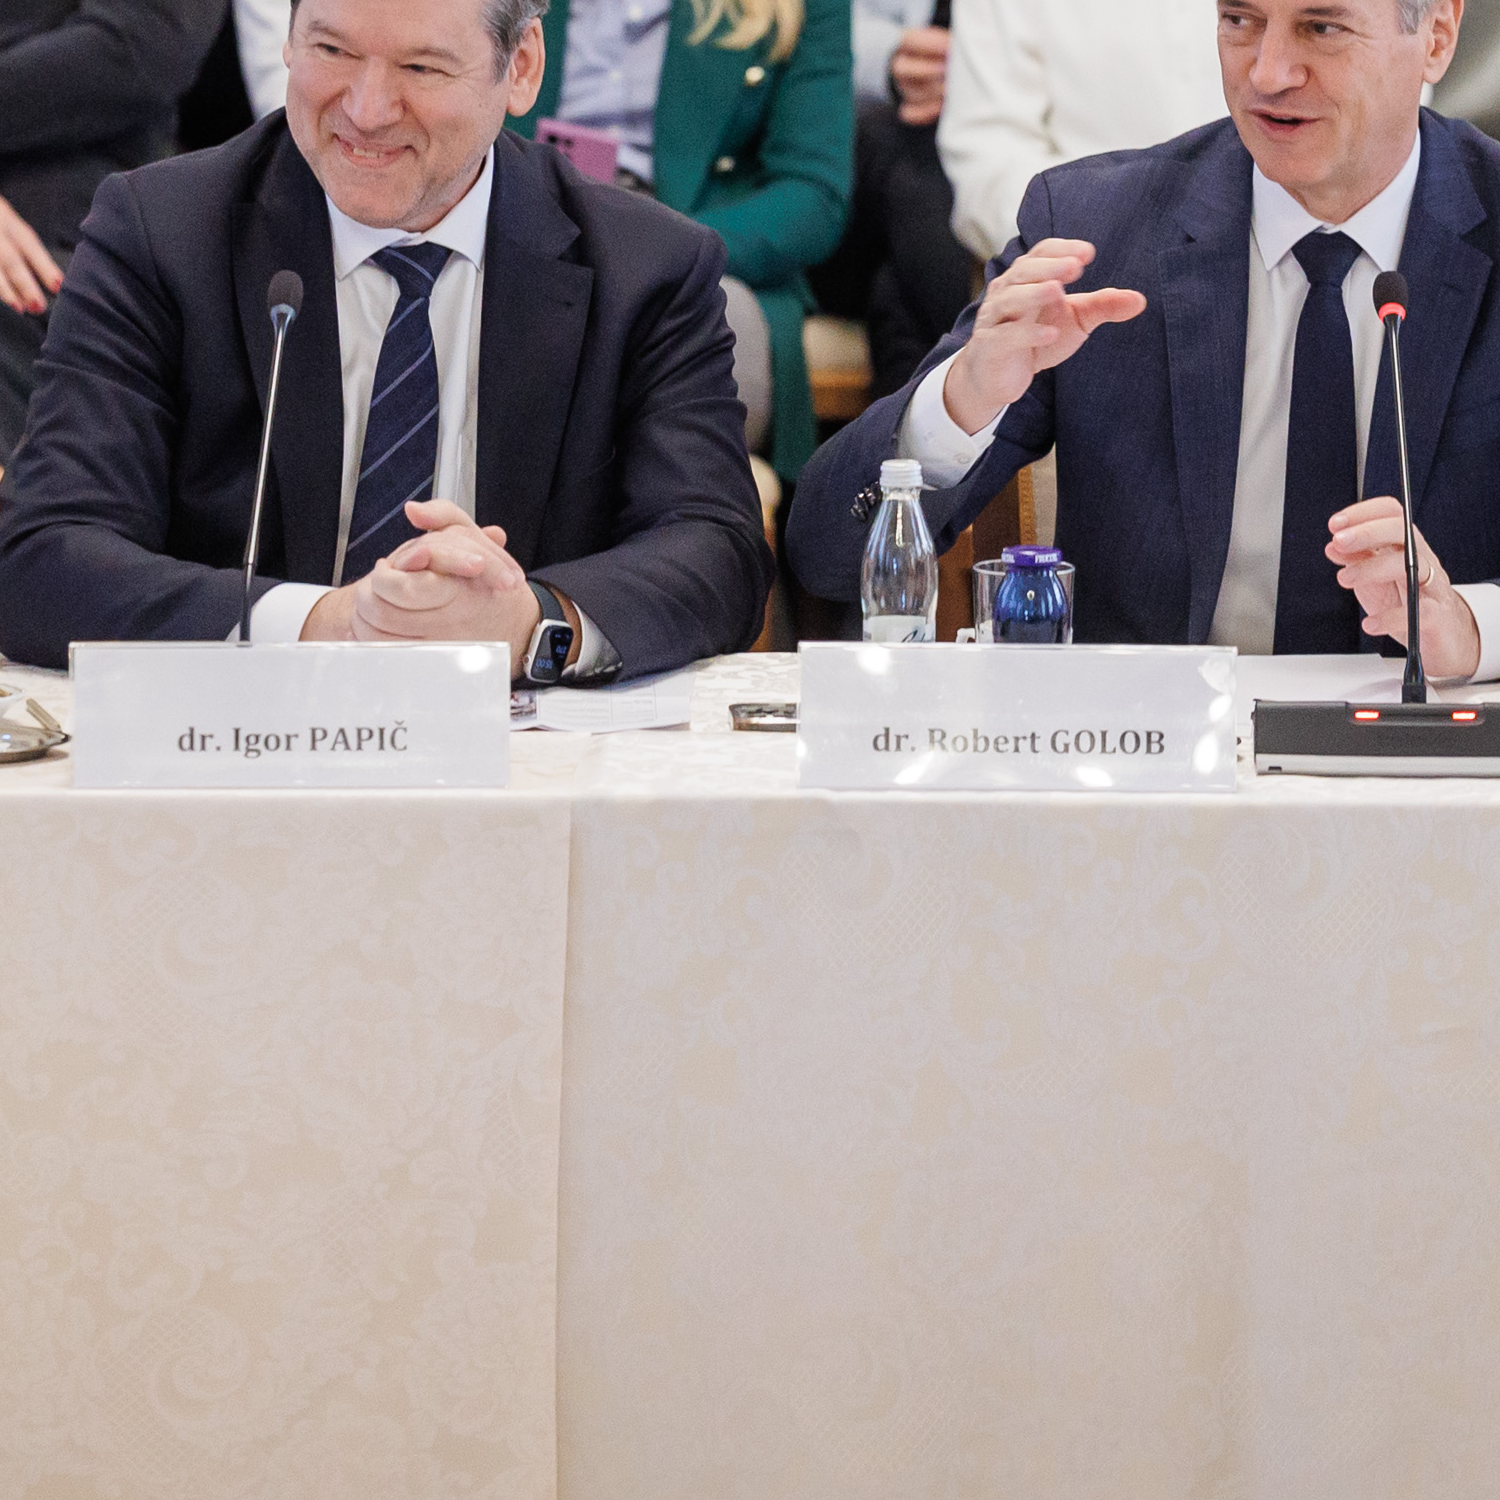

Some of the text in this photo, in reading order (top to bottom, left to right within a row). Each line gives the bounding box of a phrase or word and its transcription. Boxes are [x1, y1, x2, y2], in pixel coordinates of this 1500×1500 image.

[177, 720, 408, 758] dr. Igor PAPIČ
[872, 726, 1165, 755] dr. Robert GOLOB
